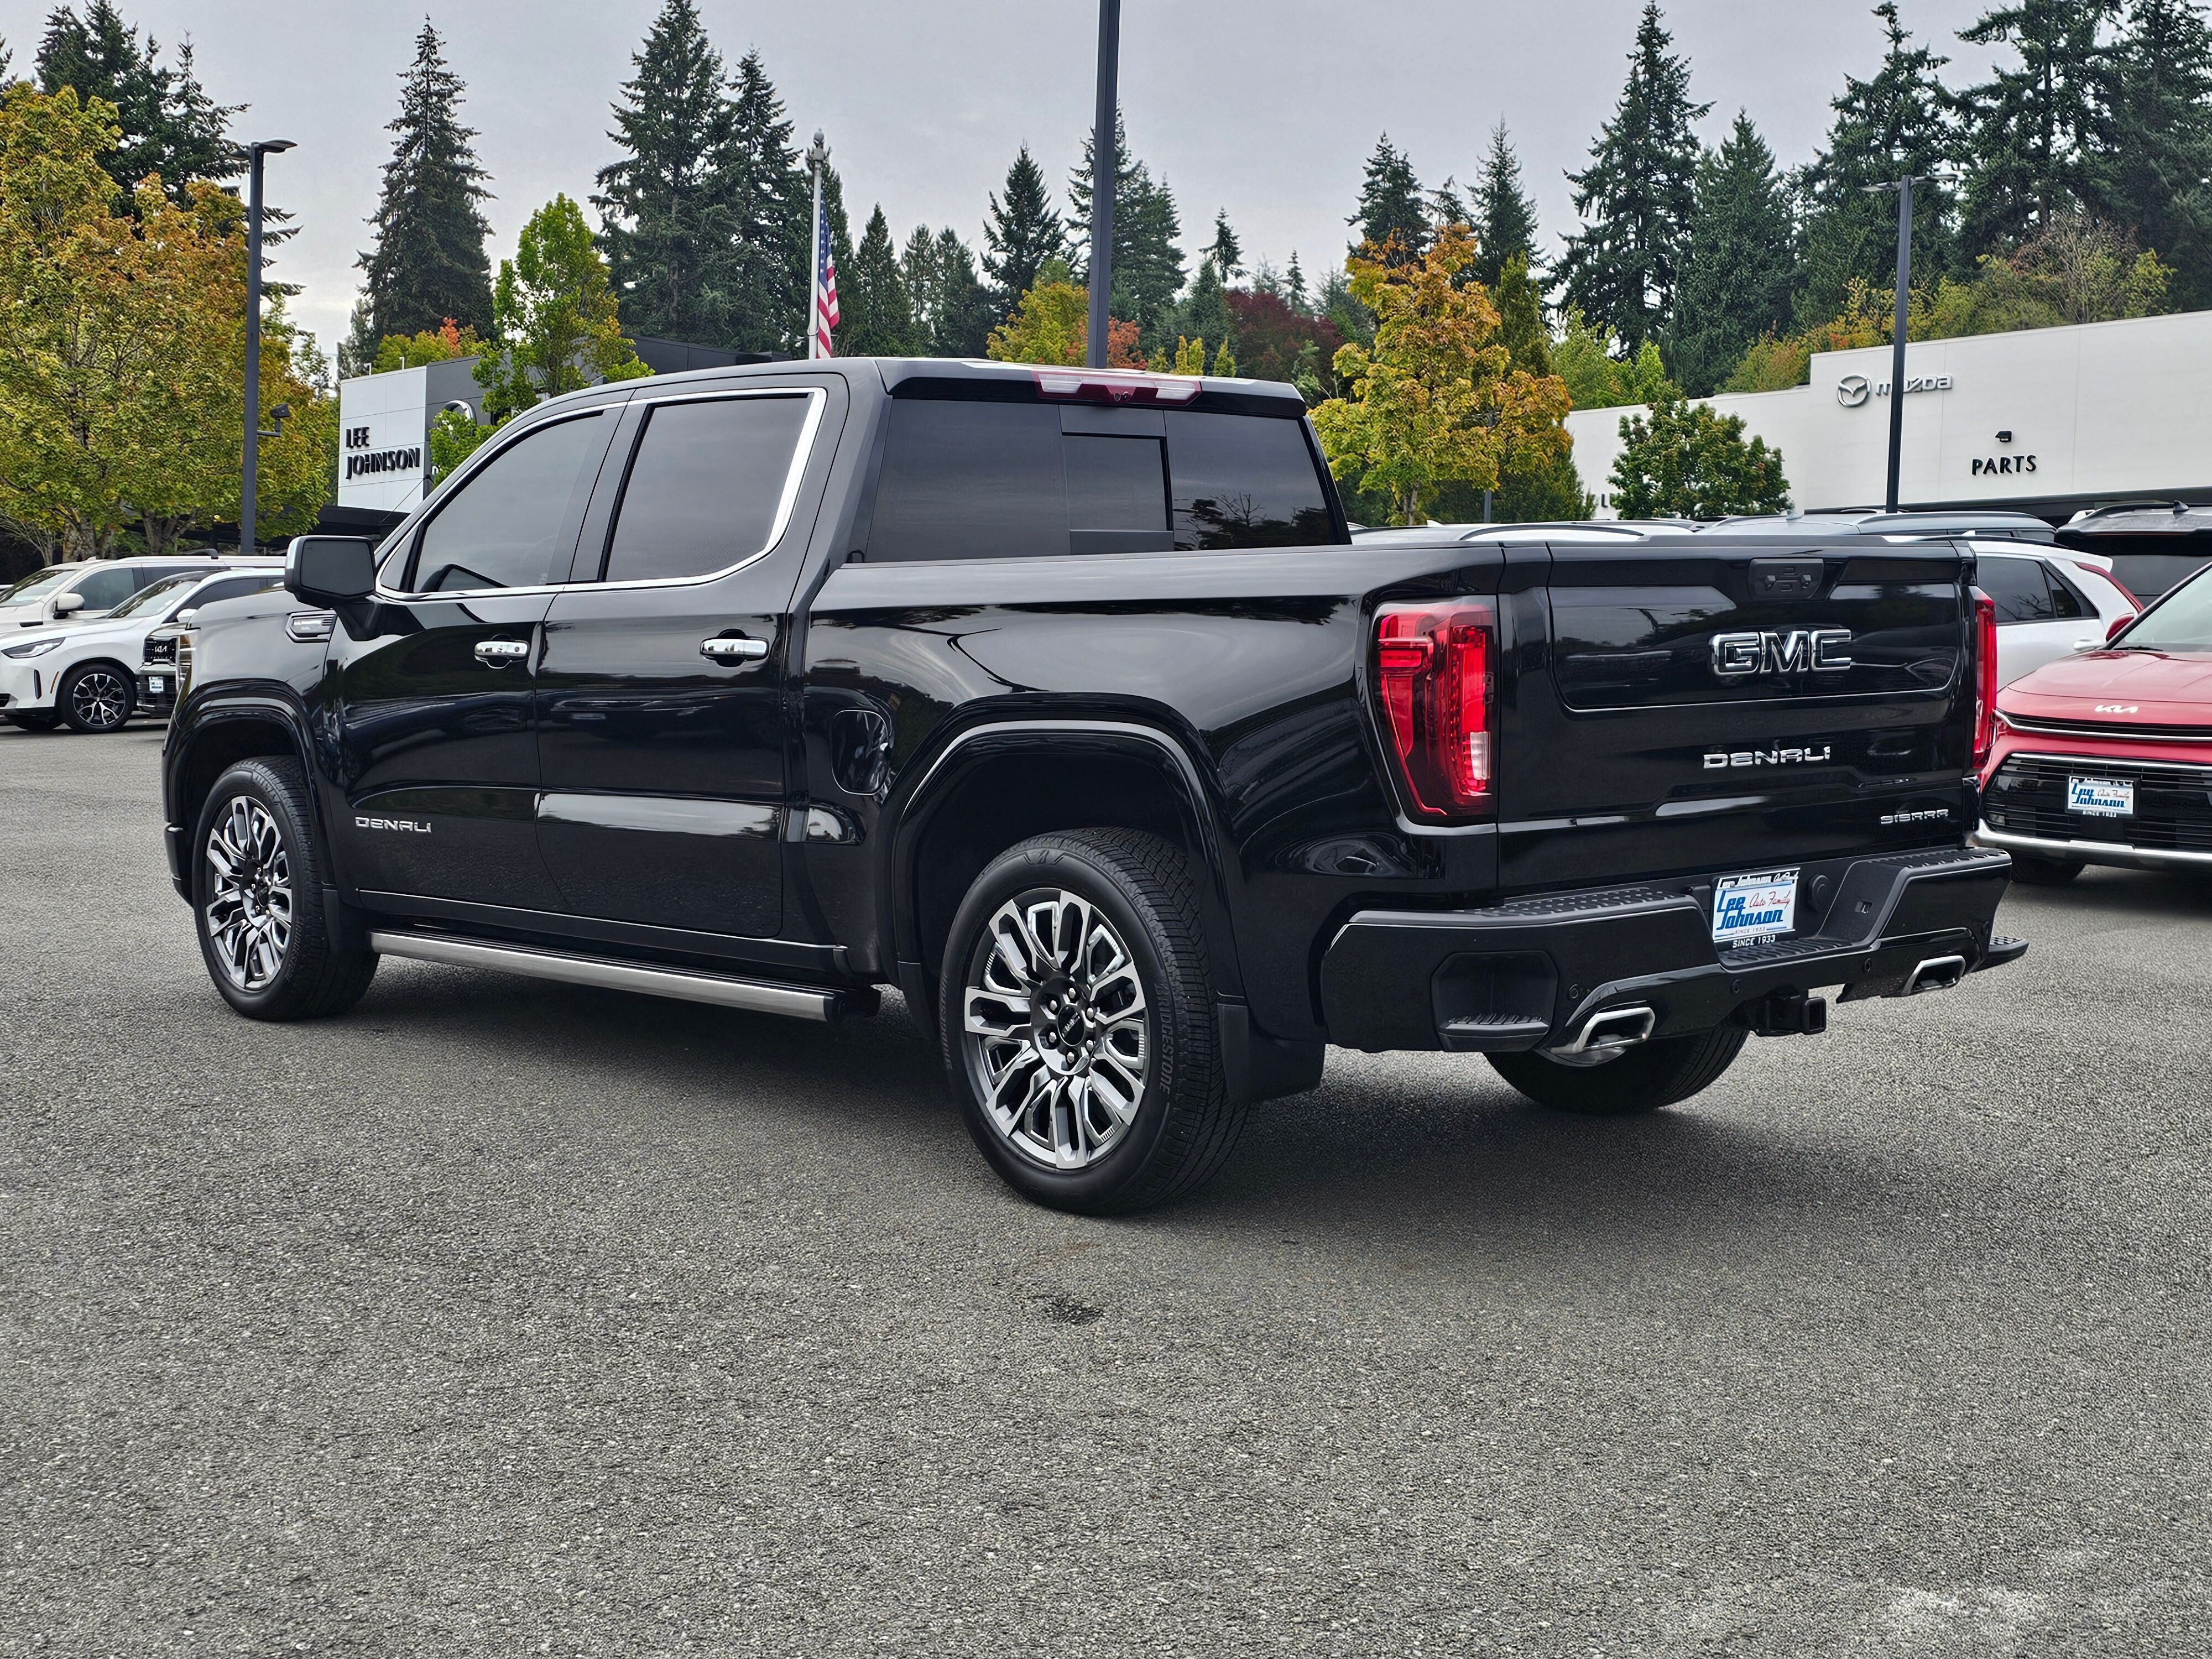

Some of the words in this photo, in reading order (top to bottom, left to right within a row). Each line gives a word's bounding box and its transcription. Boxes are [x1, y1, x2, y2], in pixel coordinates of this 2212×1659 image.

[346, 426, 370, 448] LEE
[346, 447, 420, 479] JOHNSON
[1971, 455, 2037, 476] PARTS
[1708, 629, 1852, 676] GMC
[1703, 746, 1830, 769] DENALI
[354, 817, 432, 833] DENALI
[1880, 808, 1949, 824] SIERRA
[1717, 890, 1746, 913] Lee
[1749, 893, 1766, 908] Auto
[1716, 907, 1783, 930] Johnson
[1732, 937, 1755, 948] SINCE
[1758, 934, 1776, 944] 1933
[1154, 982, 1173, 1095] BRIDGESTONE
